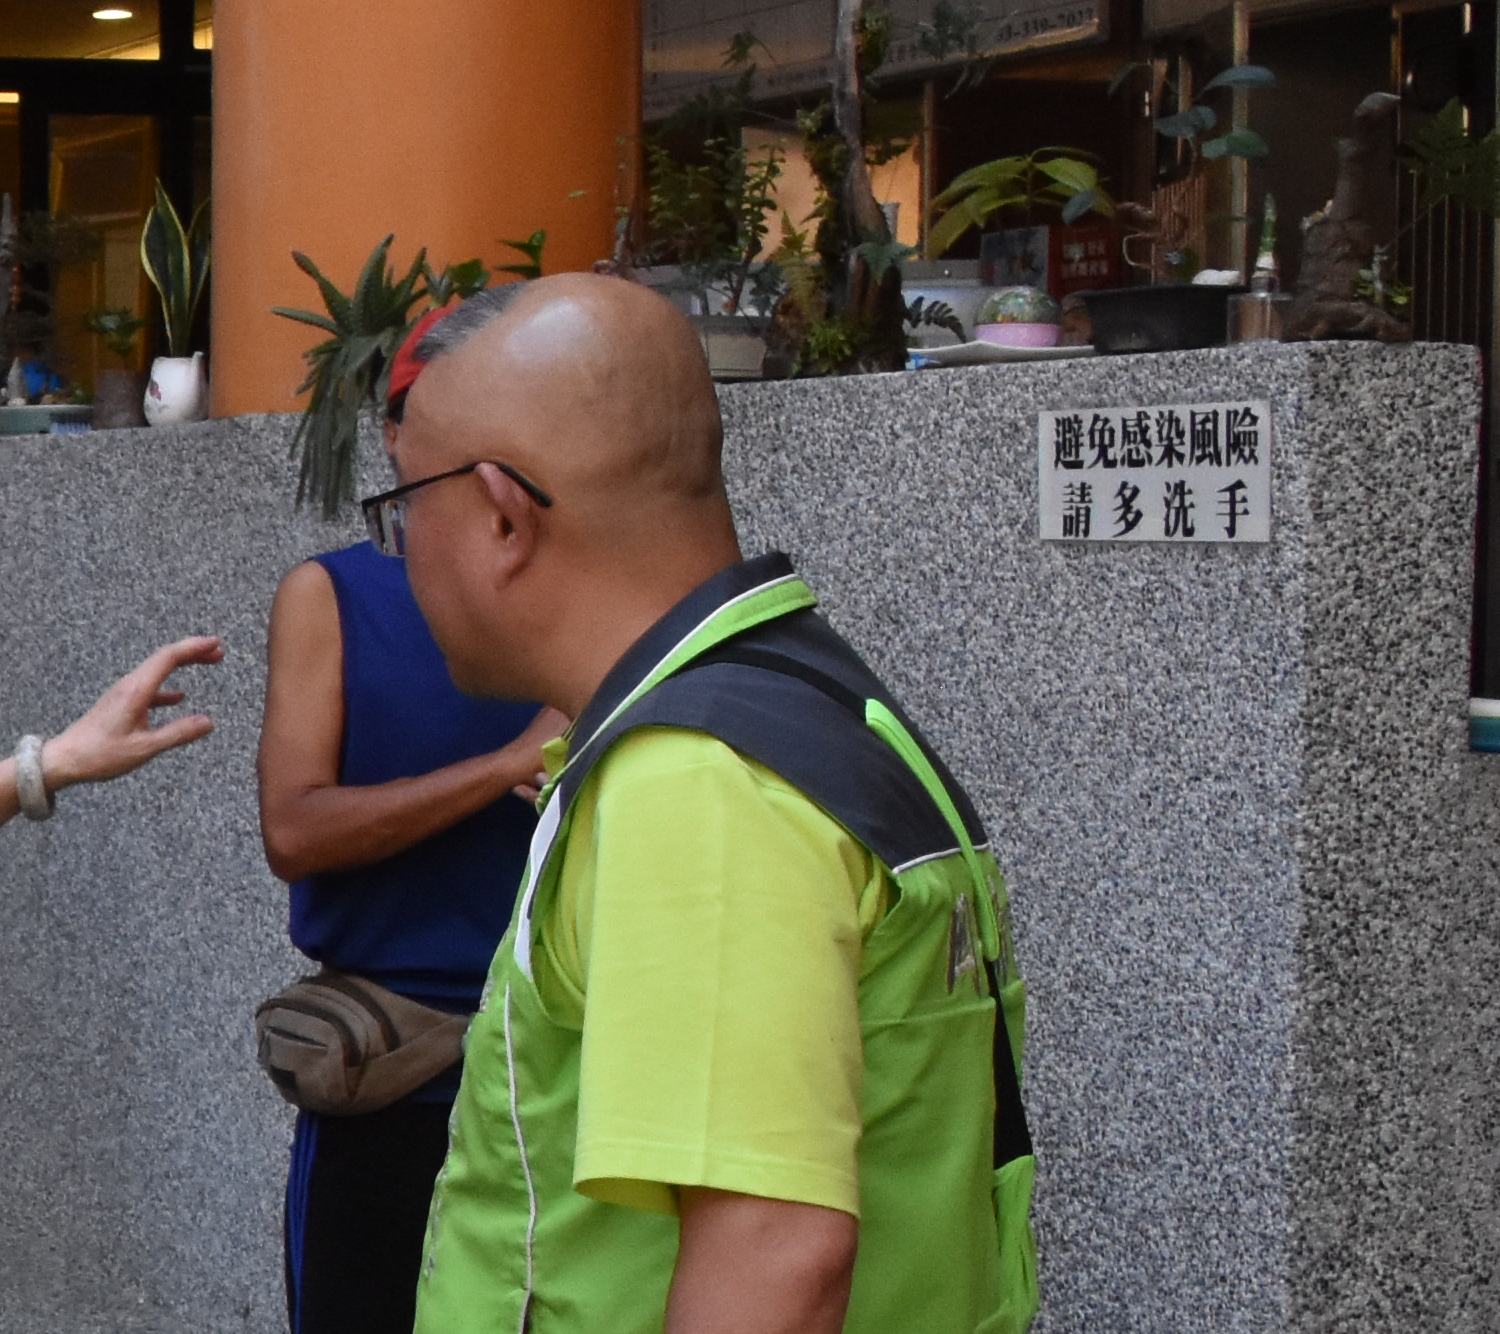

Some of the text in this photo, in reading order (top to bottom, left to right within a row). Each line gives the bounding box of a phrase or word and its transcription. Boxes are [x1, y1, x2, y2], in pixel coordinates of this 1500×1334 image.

[1054, 406, 1260, 470] 避免感染風險
[1062, 479, 1250, 539] 請多洗手
